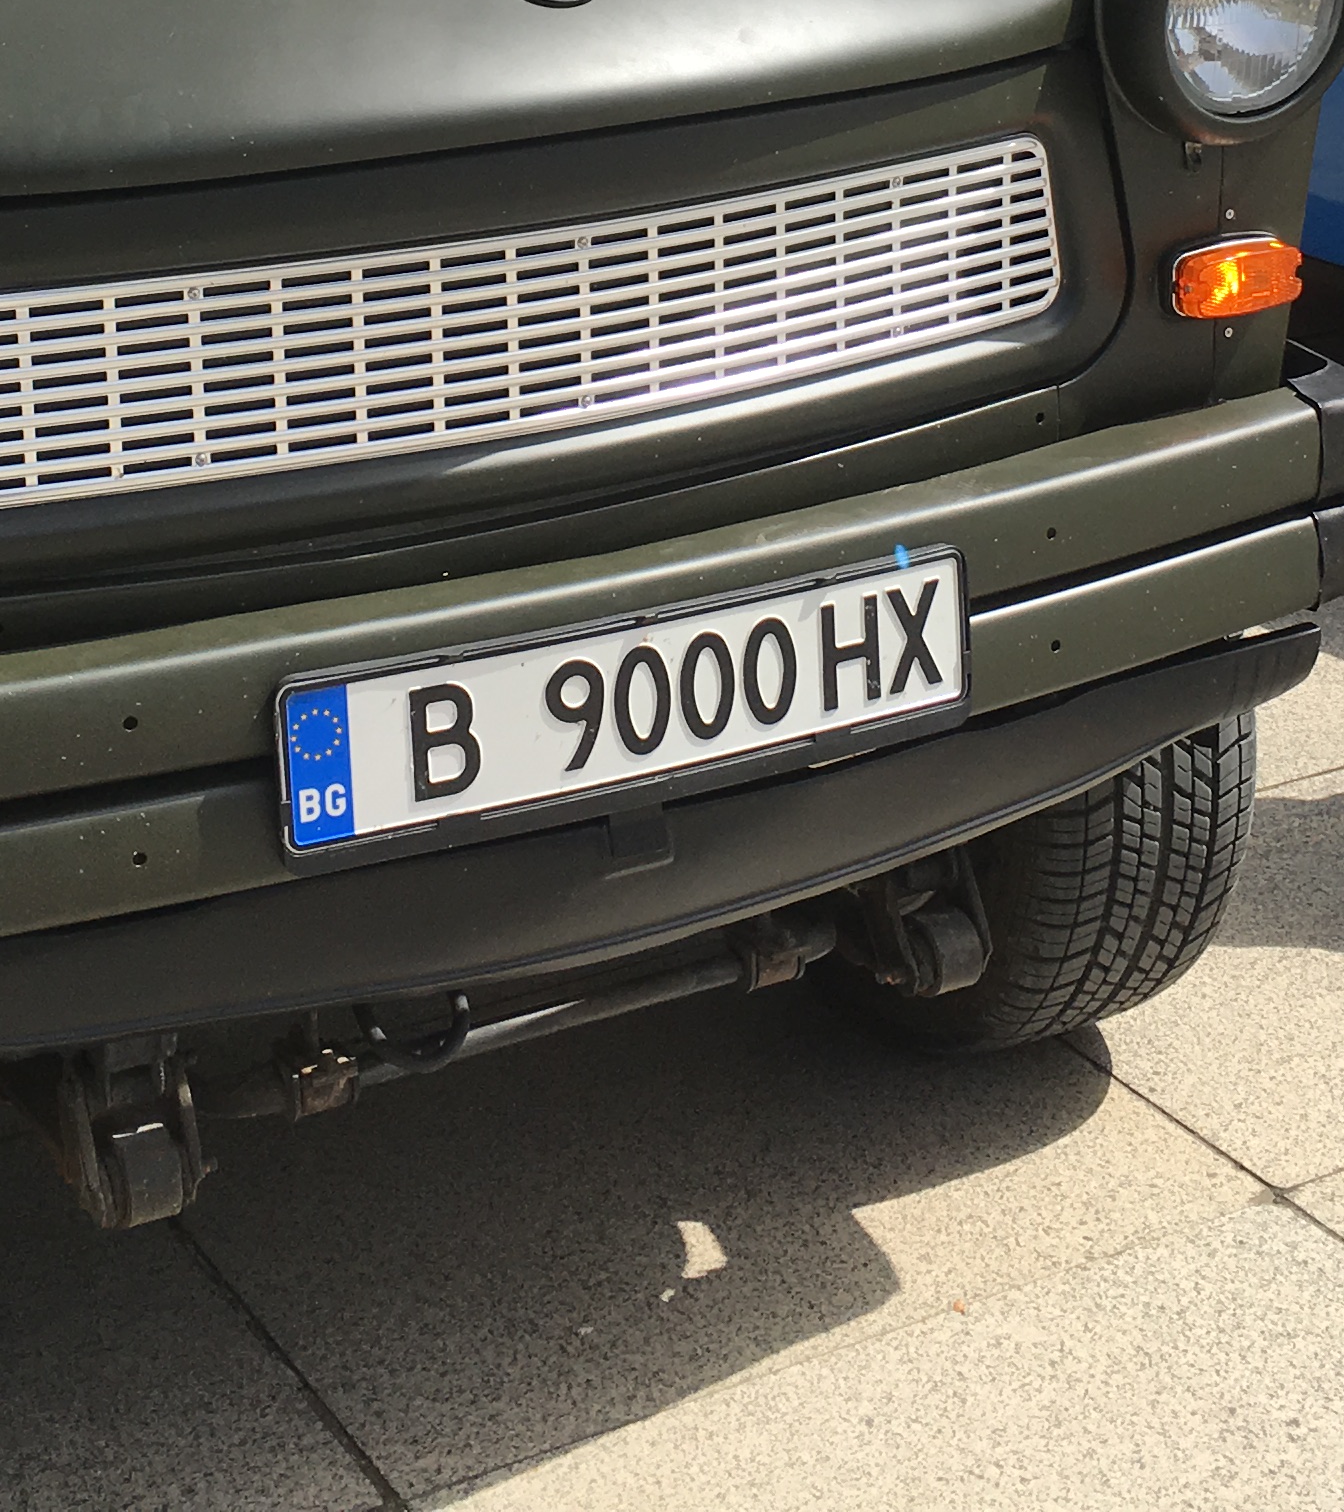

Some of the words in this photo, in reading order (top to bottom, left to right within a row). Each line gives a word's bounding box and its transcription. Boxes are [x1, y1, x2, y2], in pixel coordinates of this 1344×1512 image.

[407, 682, 482, 802] B
[544, 616, 798, 772] 9000
[819, 578, 944, 712] HX
[298, 784, 347, 825] BG
